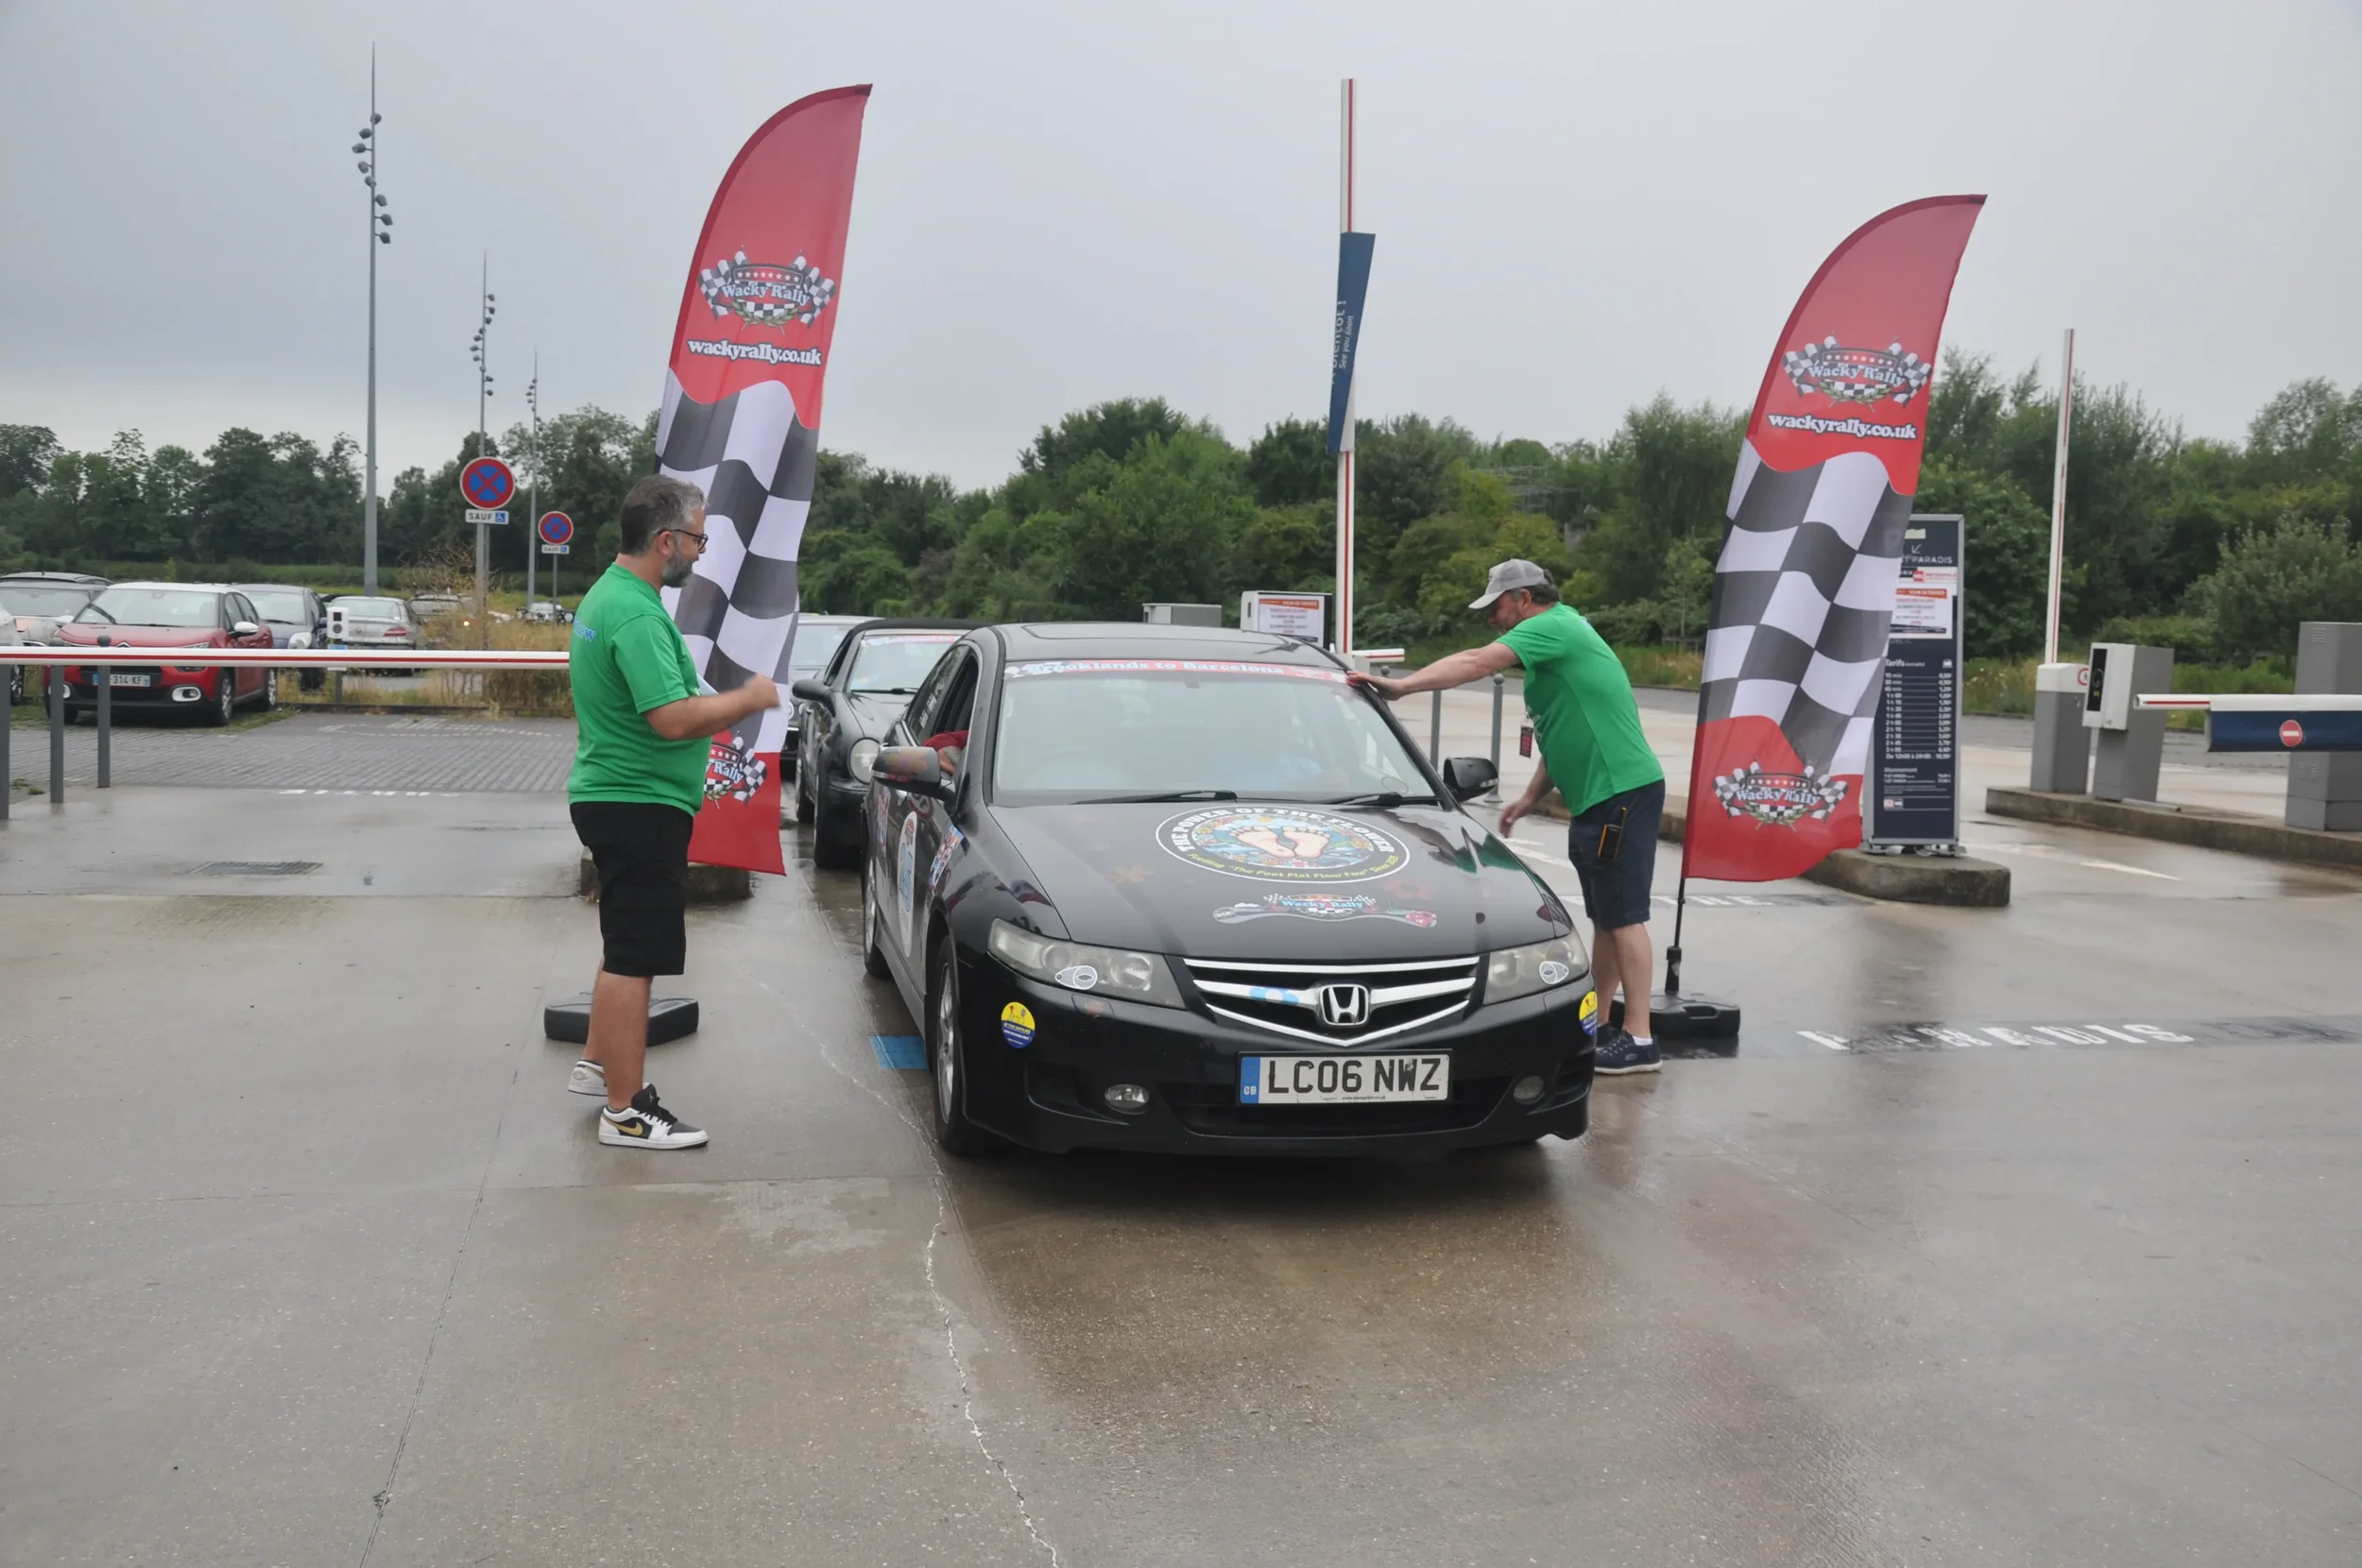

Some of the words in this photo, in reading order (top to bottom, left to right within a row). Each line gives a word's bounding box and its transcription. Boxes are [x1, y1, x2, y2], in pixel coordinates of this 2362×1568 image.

[721, 281, 769, 298] Wacky
[771, 283, 811, 306] Rally
[1345, 315, 1355, 336] soon
[688, 339, 822, 366] wackyrally.co.uk
[1342, 336, 1352, 353] you
[1338, 353, 1349, 369] See
[1807, 364, 1862, 380] Wacky
[1864, 366, 1906, 387] Rally
[1768, 414, 1918, 439] wackyrally.co.uk
[469, 512, 493, 520] SAUF
[1912, 555, 1953, 564] PARADIS
[1154, 661, 1176, 670] to
[1183, 662, 1285, 674] Barcelona
[1885, 658, 1905, 667] Tarifs
[713, 761, 745, 784] Rally
[1735, 787, 1783, 802] Wacky
[1784, 789, 1820, 806] Rally
[1172, 810, 1233, 833] POWER
[1273, 809, 1326, 820] THE
[1171, 833, 1195, 853] THE
[1326, 818, 1395, 853] FLOWER
[1268, 1060, 1363, 1094] LC06
[1373, 1058, 1442, 1092] NWZ
[1243, 1085, 1257, 1096] GB
